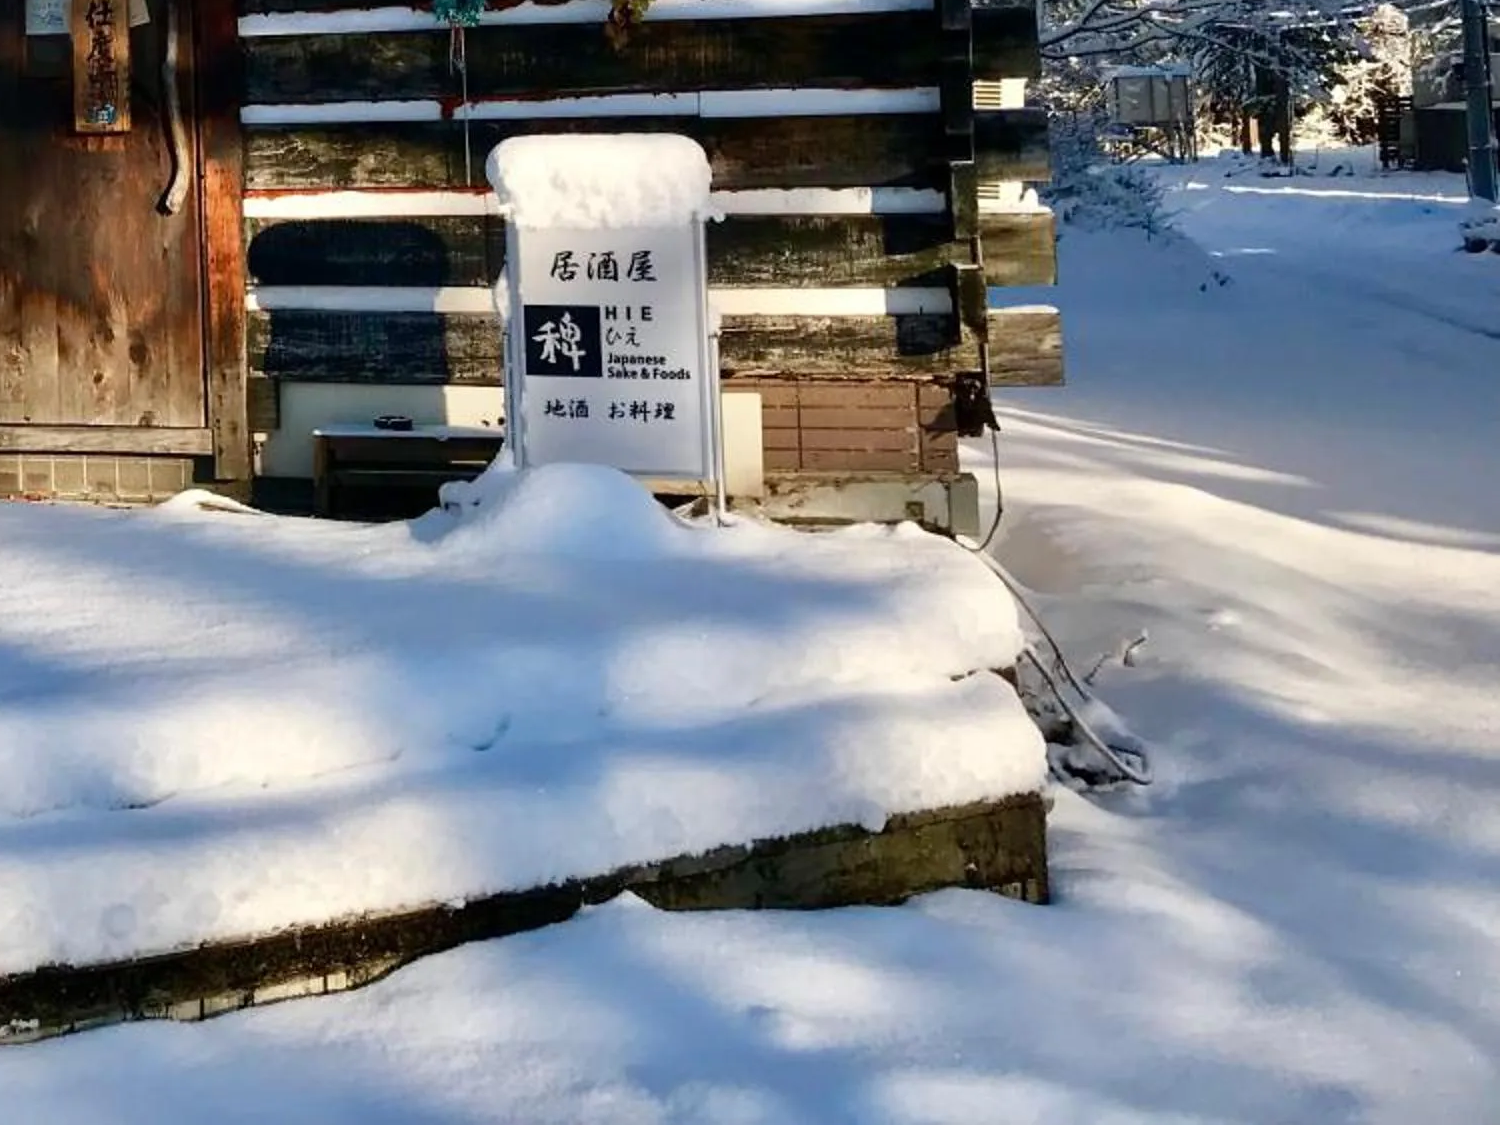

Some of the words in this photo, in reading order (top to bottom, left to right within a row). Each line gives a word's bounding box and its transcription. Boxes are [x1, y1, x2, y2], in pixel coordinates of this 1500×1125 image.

[550, 250, 658, 282] 居酒屋
[604, 305, 653, 322] HIE
[532, 311, 587, 372] 稗
[605, 326, 640, 348] ひえ
[607, 352, 666, 367] Japanese
[607, 366, 638, 379] Sake
[640, 367, 650, 379] &
[652, 367, 691, 379] Foods
[543, 399, 590, 420] 地酒
[607, 400, 675, 423] お料理
